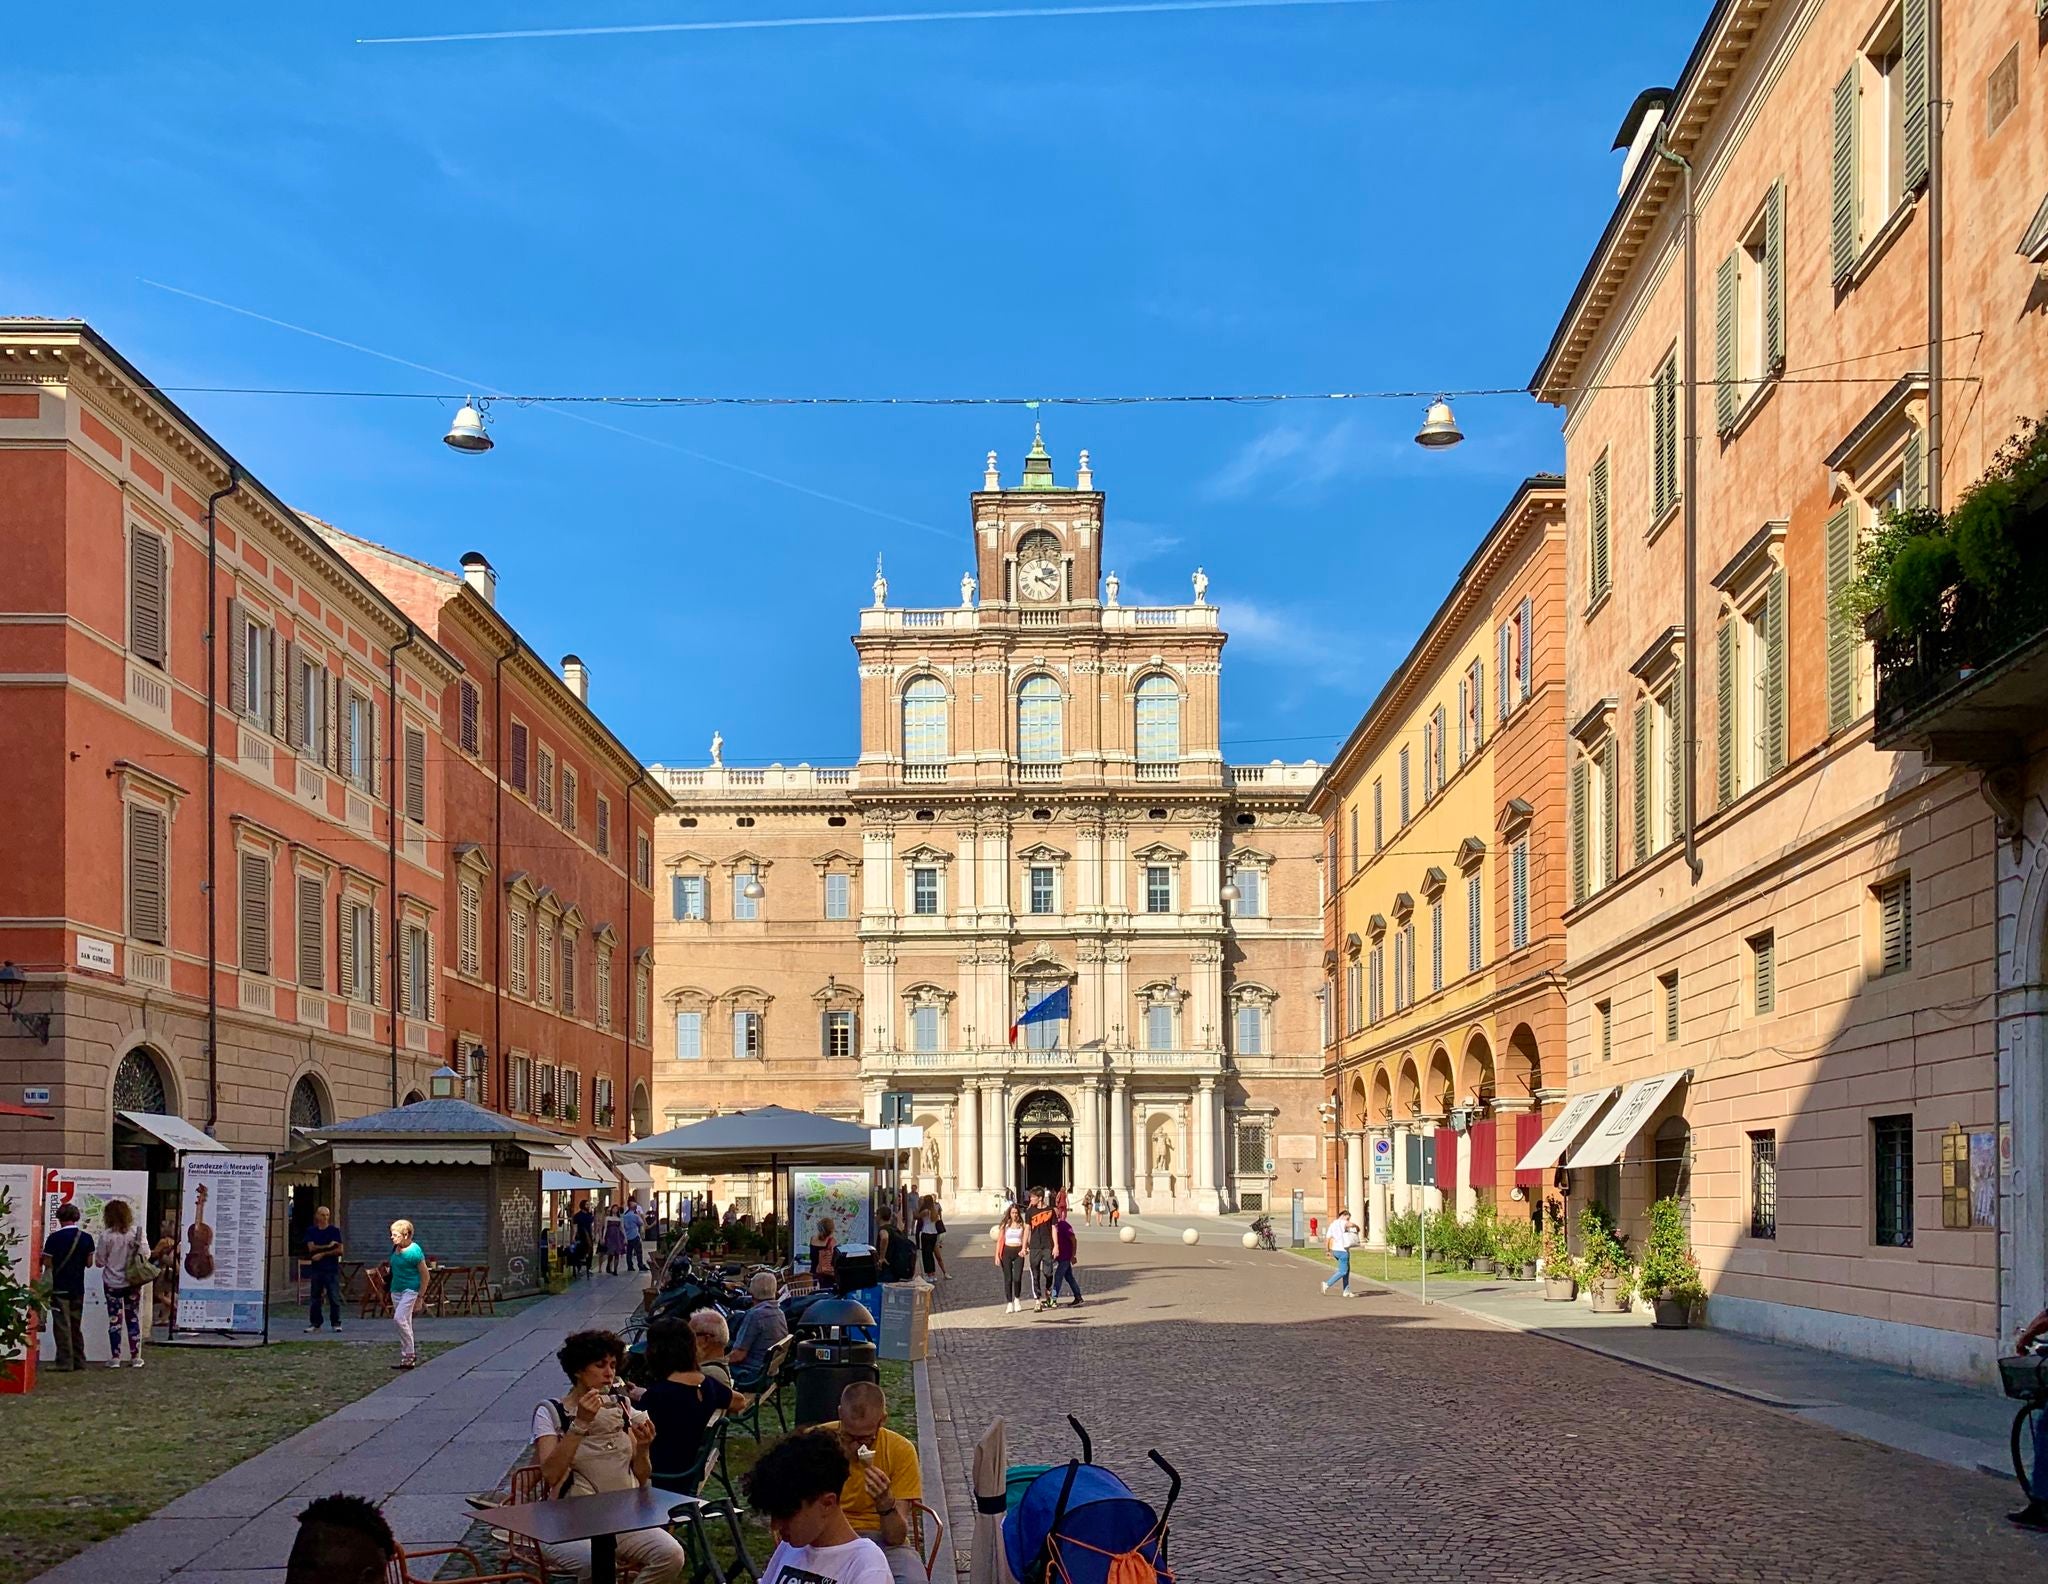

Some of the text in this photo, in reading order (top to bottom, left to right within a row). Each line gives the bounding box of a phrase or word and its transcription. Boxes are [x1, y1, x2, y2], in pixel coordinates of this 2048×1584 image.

[80, 952, 91, 960] SAN
[1634, 1086, 1658, 1102] COT
[188, 1161, 264, 1173] Grandezze & Meraviglie
